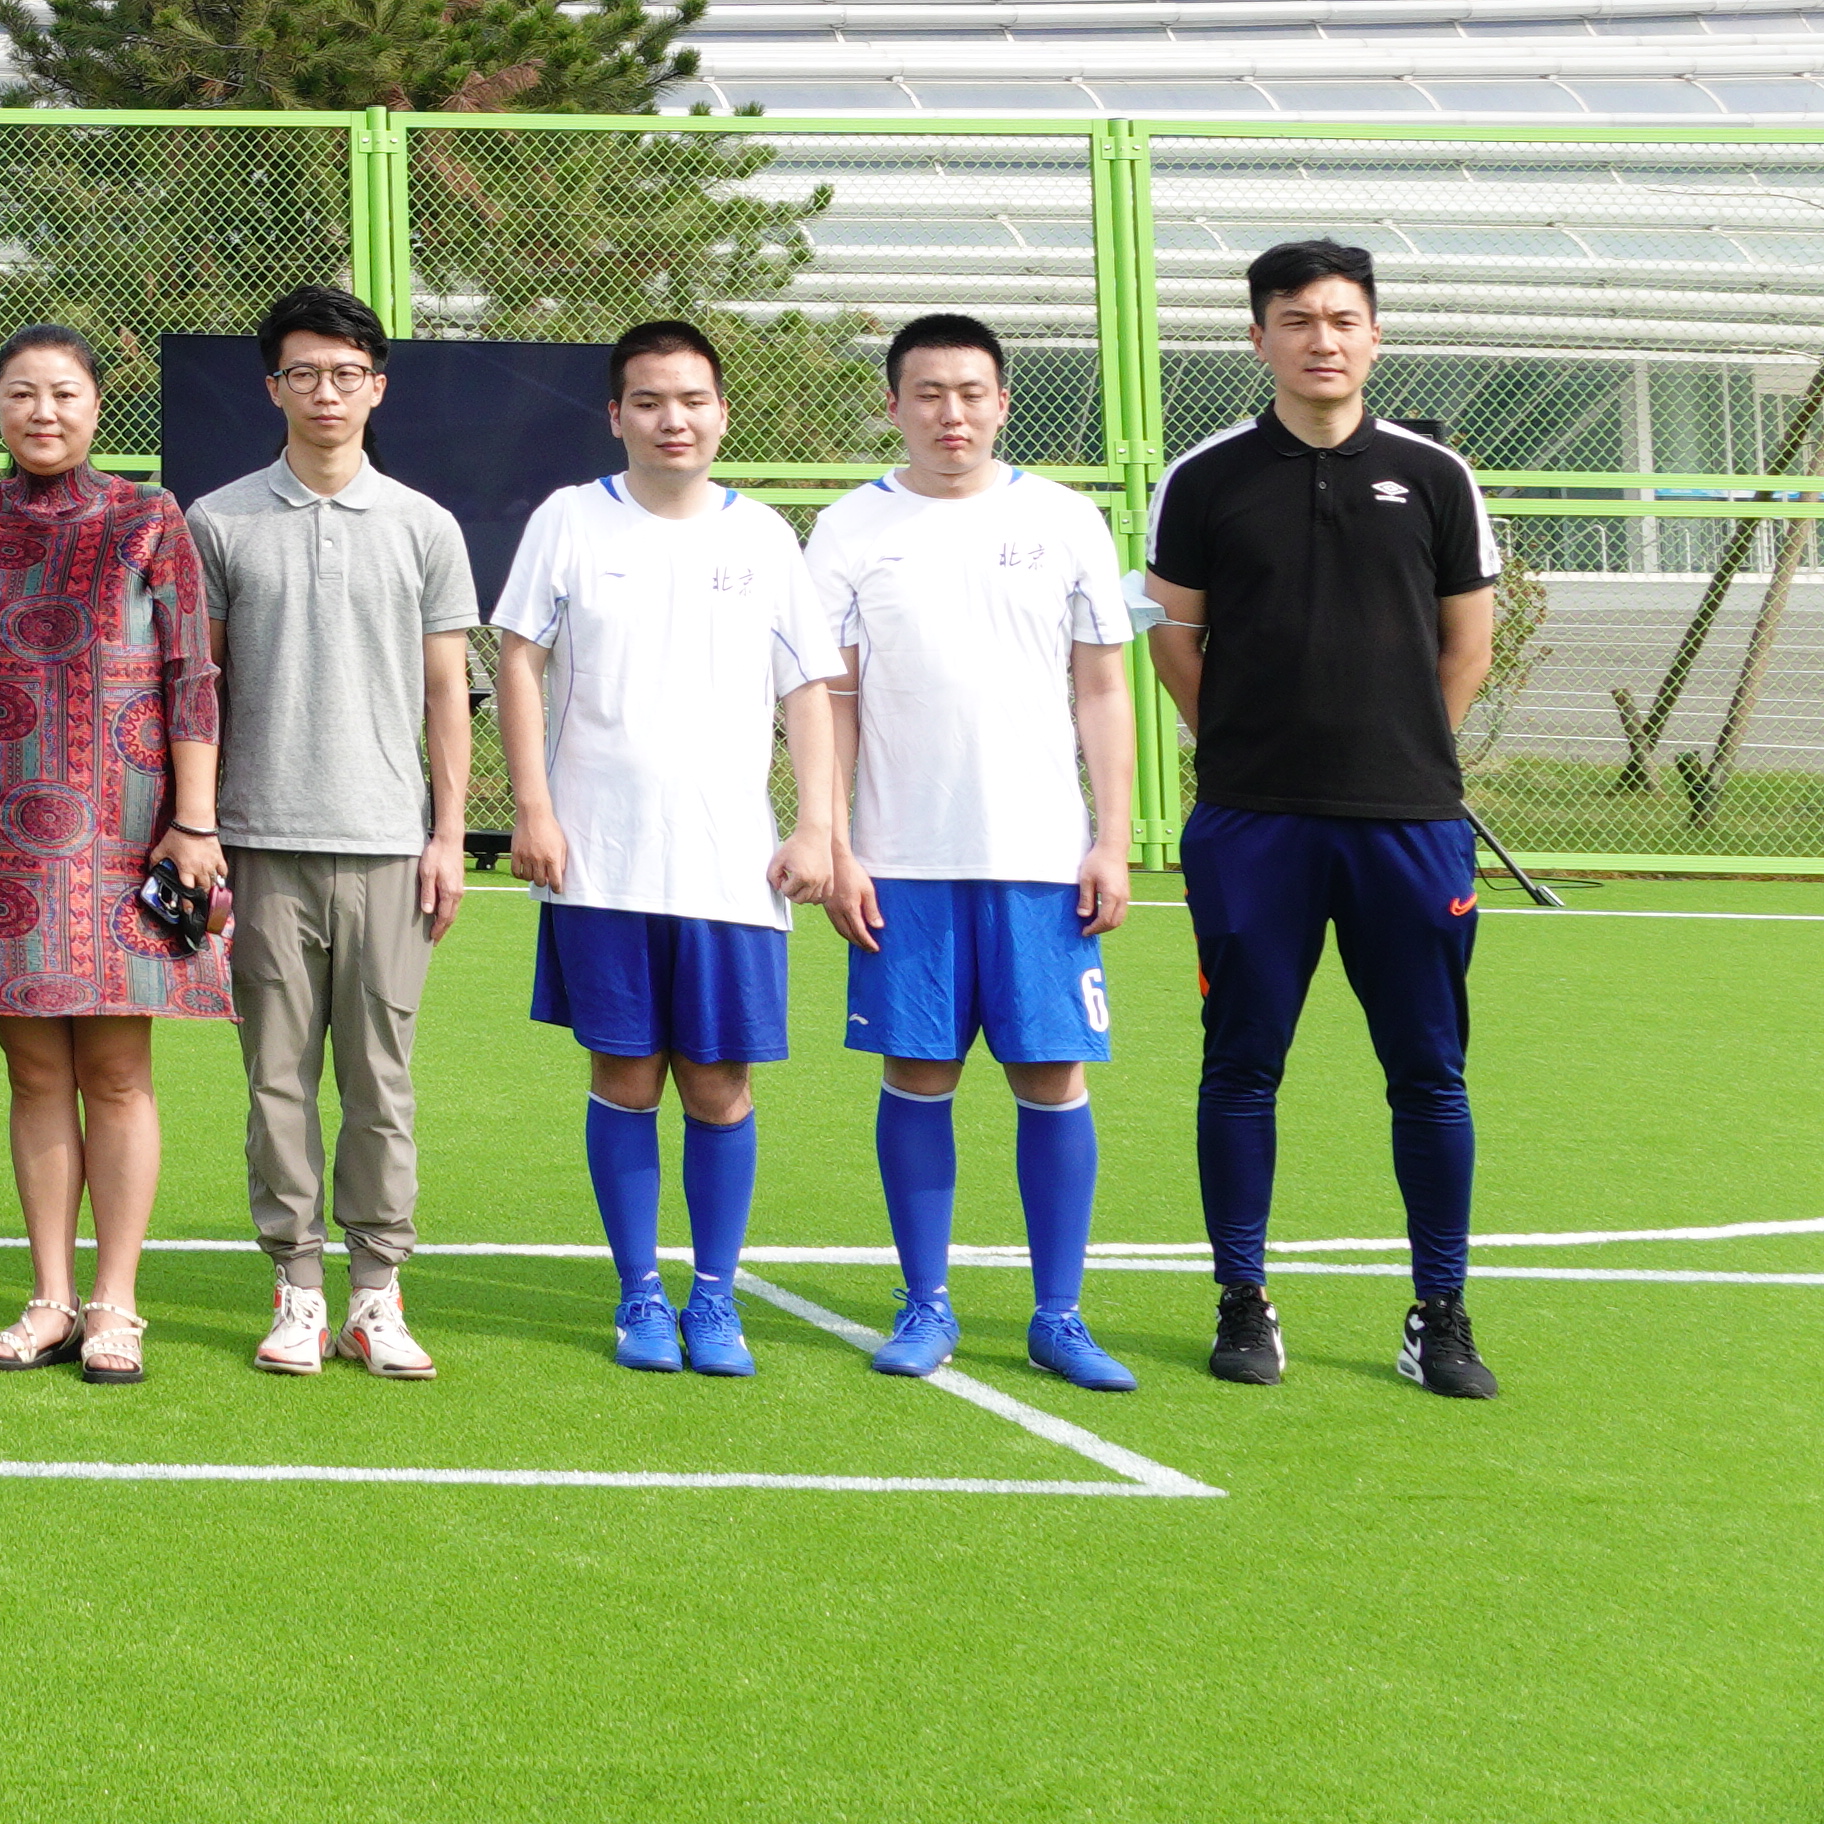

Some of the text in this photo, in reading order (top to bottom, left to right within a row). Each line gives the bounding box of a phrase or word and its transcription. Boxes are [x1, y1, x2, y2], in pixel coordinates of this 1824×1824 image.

[998, 541, 1045, 571] 北京
[712, 566, 754, 597] 北京
[1081, 967, 1109, 1033] 6
